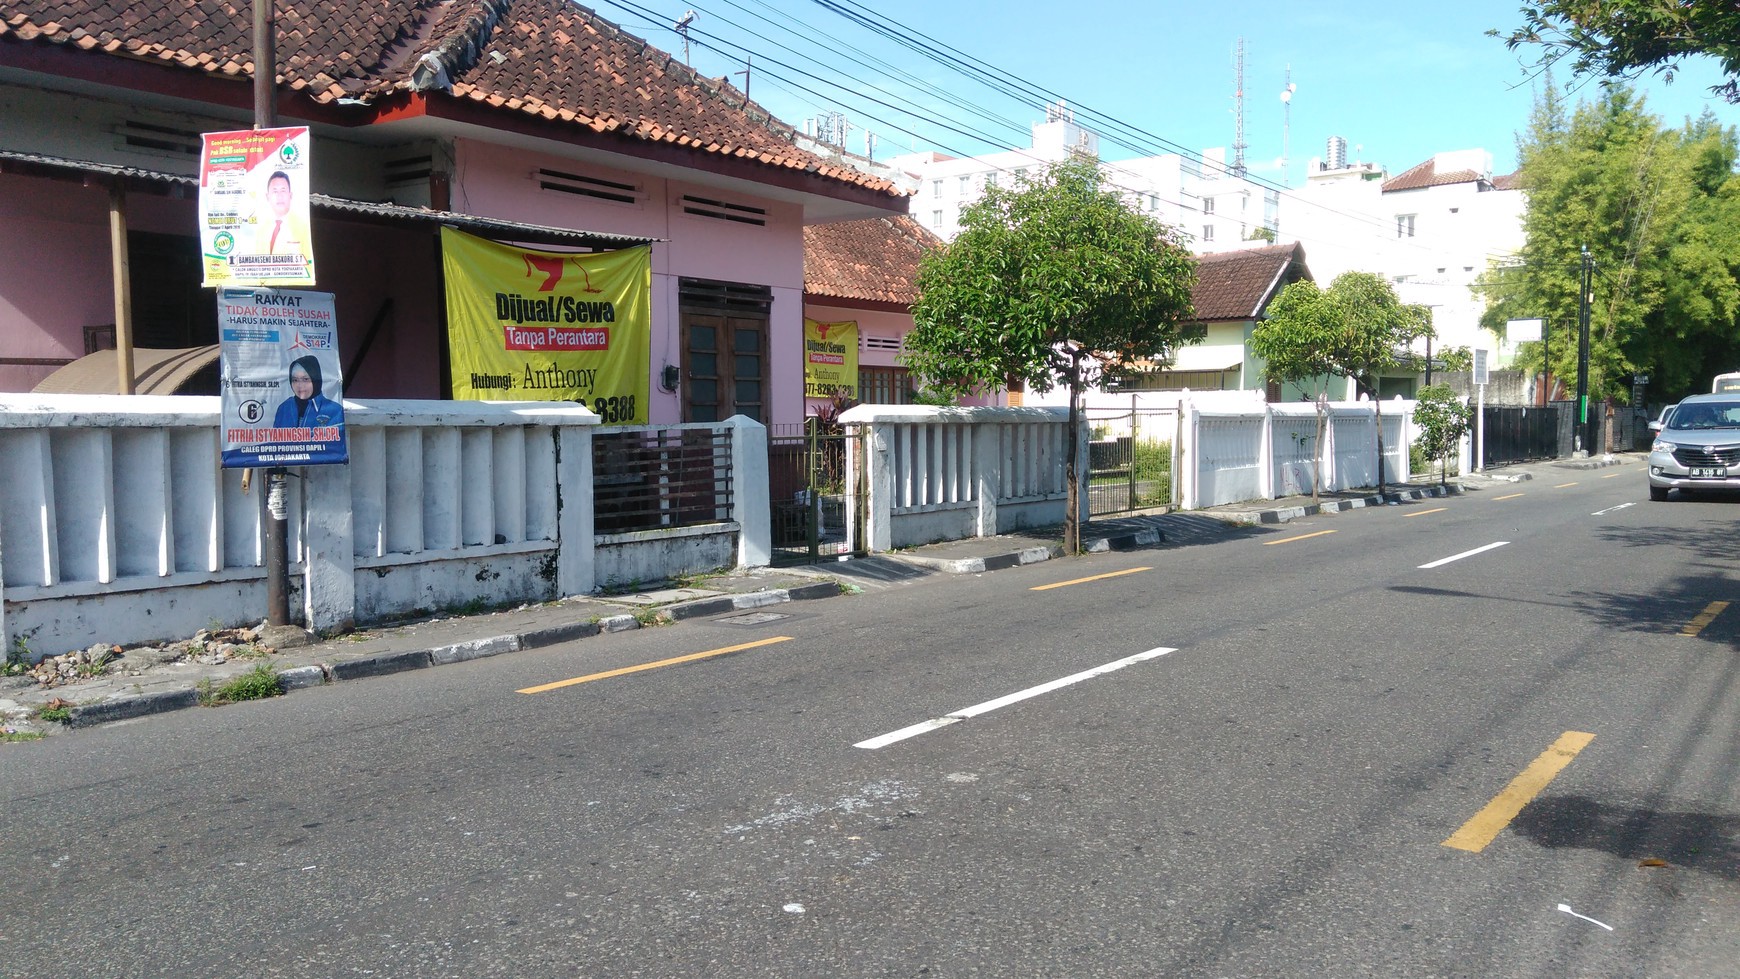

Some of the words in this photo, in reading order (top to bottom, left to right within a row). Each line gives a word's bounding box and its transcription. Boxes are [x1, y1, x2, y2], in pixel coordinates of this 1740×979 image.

[228, 256, 235, 264] 1
[255, 294, 302, 307] RAKYAT
[495, 292, 615, 323] Dijual/Sewa
[225, 305, 259, 316] TIDAK
[262, 307, 294, 317] BOLEH
[298, 309, 331, 320] SUSAH
[260, 318, 286, 326] MAKIN
[507, 326, 545, 349] Tanpa
[548, 328, 606, 345] Perantara
[807, 340, 846, 354] Dijual/Sewa
[470, 372, 517, 391] Hubungi:
[522, 361, 597, 395] Anthony
[814, 368, 840, 383] Anthony
[247, 403, 257, 420] 6
[227, 428, 254, 442] FITRIA
[255, 427, 311, 442] ISTYANINGSIH
[241, 445, 259, 453] CALEG
[260, 445, 277, 453] DPRD
[278, 444, 305, 452] PROVINSI
